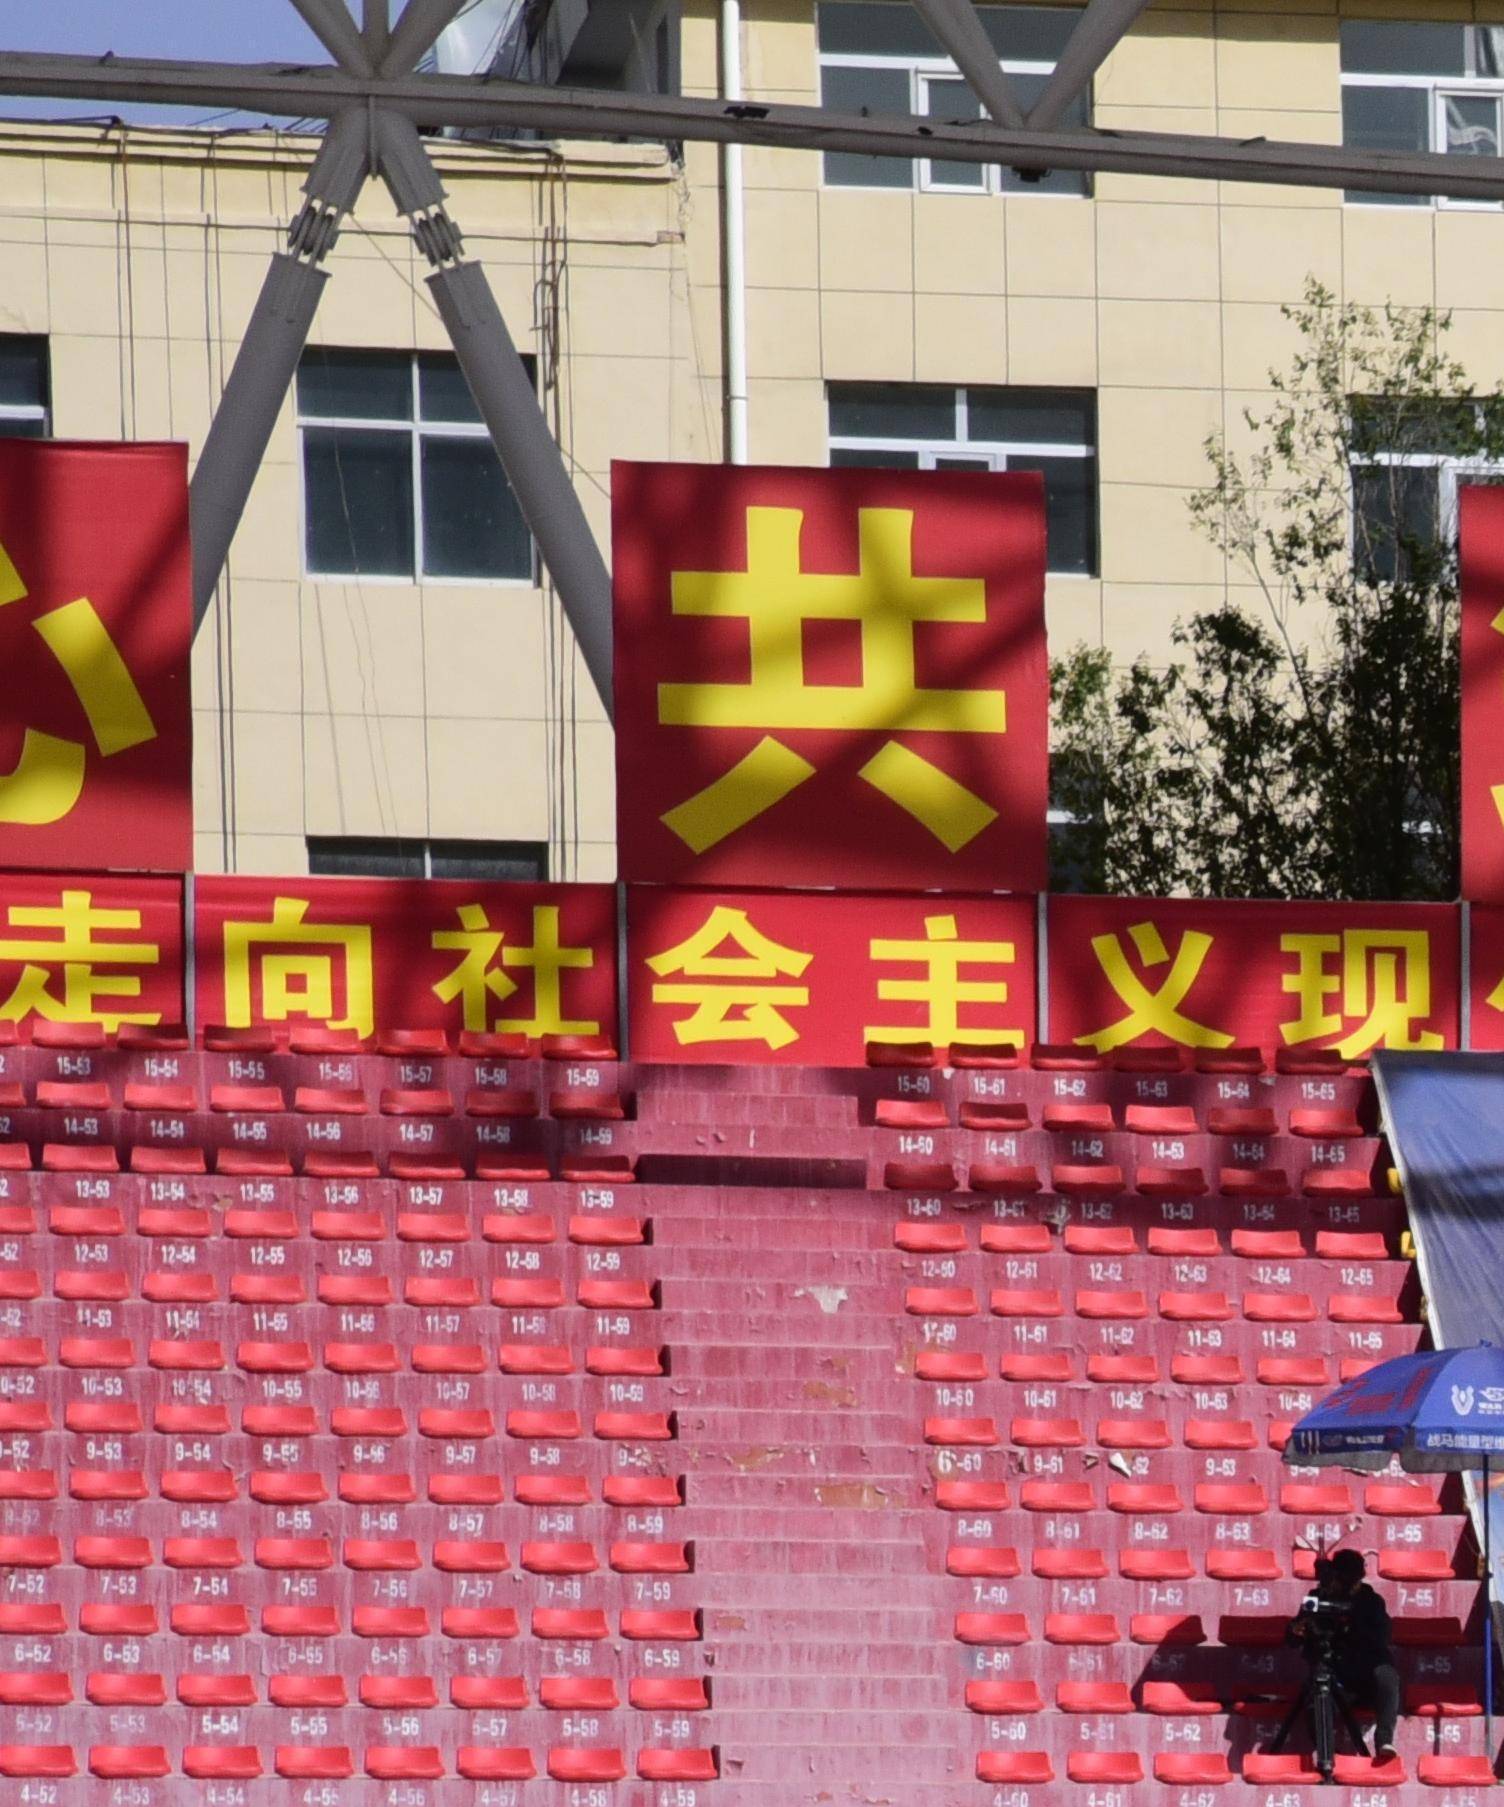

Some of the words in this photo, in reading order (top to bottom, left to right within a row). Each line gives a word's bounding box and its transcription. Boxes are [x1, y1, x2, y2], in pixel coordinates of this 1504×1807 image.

[56, 1055, 90, 1075] 15-53
[227, 1059, 265, 1080] 15-55
[566, 1068, 600, 1087] 15-59
[973, 1076, 1005, 1096] 15-61
[1053, 1077, 1086, 1097] 15-62
[63, 1117, 98, 1136] 14-53
[306, 1121, 341, 1141] 14-56
[399, 1123, 434, 1142] 14-57
[985, 1137, 1017, 1158] 14-61
[1152, 1141, 1185, 1160] 14-63
[75, 1179, 110, 1199] 13-53
[240, 1183, 275, 1203] 13-55
[409, 1185, 443, 1206] 13-57
[74, 1243, 109, 1263] 12-53
[250, 1245, 286, 1265] 12-55
[419, 1248, 454, 1269] 12-57
[585, 1251, 621, 1272] 12-59
[1257, 1266, 1292, 1285] 12-64
[1340, 1267, 1374, 1286] 12-65
[253, 1311, 288, 1332] 11-55
[596, 1315, 630, 1335] 11-59
[1013, 1324, 1048, 1344] 11-61
[1261, 1329, 1297, 1348] 11-64
[1348, 1331, 1383, 1350] 11-65
[81, 1376, 123, 1396] 10-53
[262, 1379, 303, 1399] 10-55
[935, 1387, 974, 1407] 10-60
[1023, 1389, 1057, 1408] 10-61
[1194, 1391, 1228, 1411] 10-63
[86, 1440, 122, 1462] 9-53
[174, 1442, 212, 1461] 9-54
[445, 1445, 476, 1465] 9-57
[1033, 1454, 1063, 1474] 9-61
[1205, 1457, 1237, 1477] 9-63
[180, 1510, 218, 1529] 8-54
[361, 1510, 398, 1531] 8-56
[448, 1512, 484, 1533] 8-57
[627, 1514, 664, 1535] 8-59
[1133, 1521, 1168, 1541] 8-62
[1386, 1523, 1423, 1543] 8-65
[8, 1574, 45, 1595] 7-52
[193, 1576, 229, 1596] 7-54
[634, 1581, 671, 1601] 7-59
[973, 1586, 1008, 1605] 7-60
[1061, 1586, 1096, 1606] 7-61
[1234, 1587, 1270, 1606] 7-63
[1397, 1588, 1434, 1607] 7-65
[14, 1643, 51, 1663] 6-52
[103, 1643, 141, 1664] 6-53
[644, 1648, 680, 1668] 6-59
[202, 1714, 240, 1735] 5-54
[383, 1716, 420, 1736] 5-56
[653, 1719, 690, 1739] 5-59
[991, 1721, 1027, 1741] 5-60
[20, 1784, 56, 1804] 4-52
